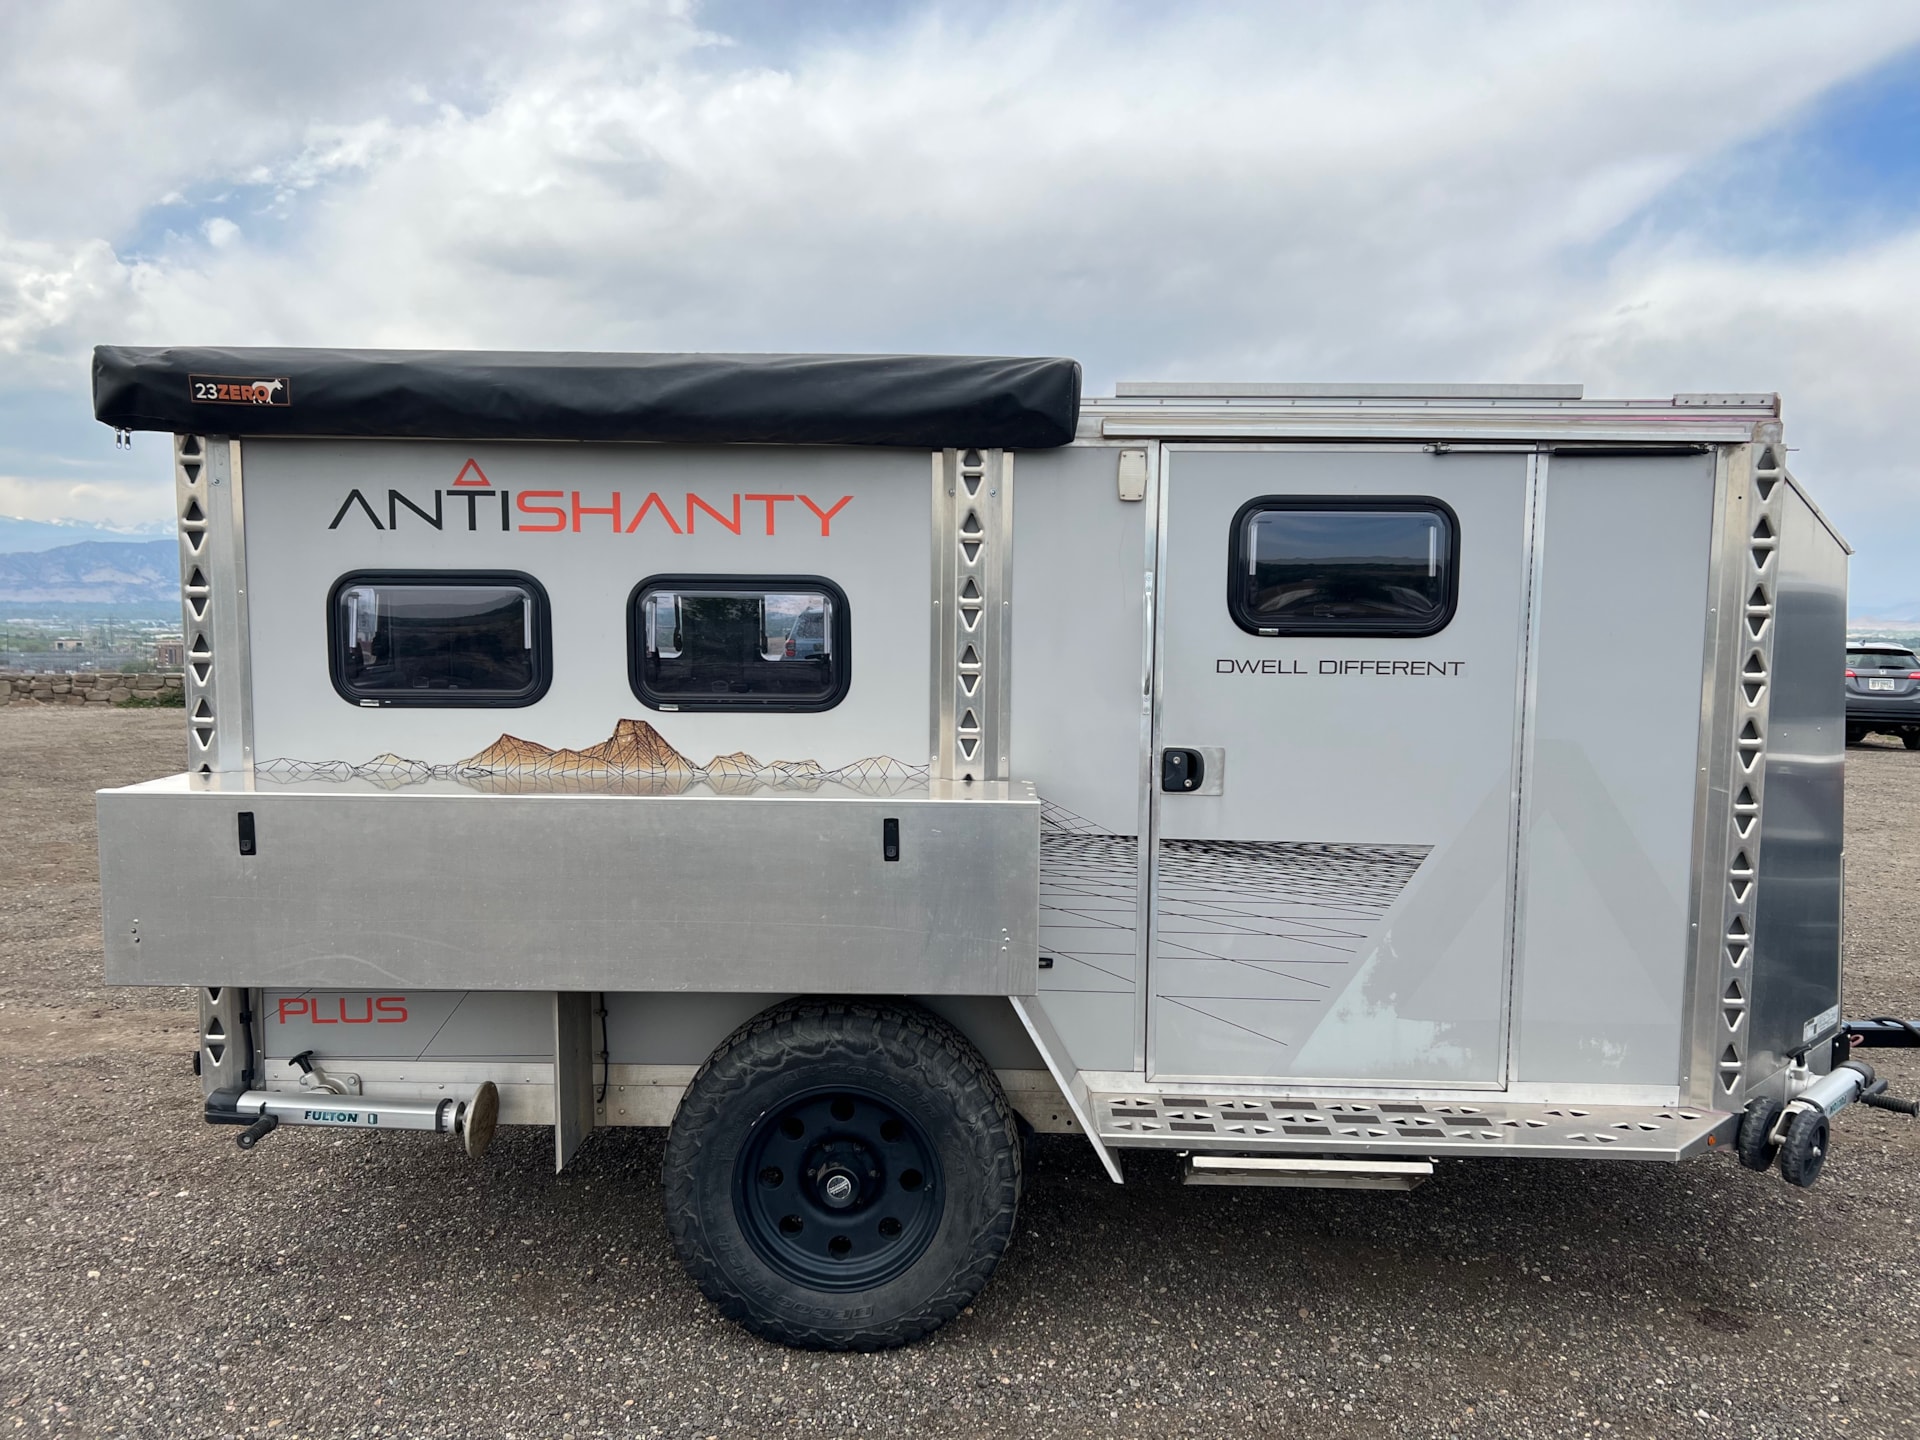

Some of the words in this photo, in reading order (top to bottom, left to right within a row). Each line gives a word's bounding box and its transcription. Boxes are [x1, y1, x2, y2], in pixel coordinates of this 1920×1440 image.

[195, 383, 269, 401] 23ZERO
[328, 488, 854, 536] ANTISHANTY
[1216, 659, 1308, 674] DWELL
[1318, 660, 1466, 676] DIFFERENT
[278, 997, 408, 1024] PLUS
[304, 1110, 358, 1123] FULTON
